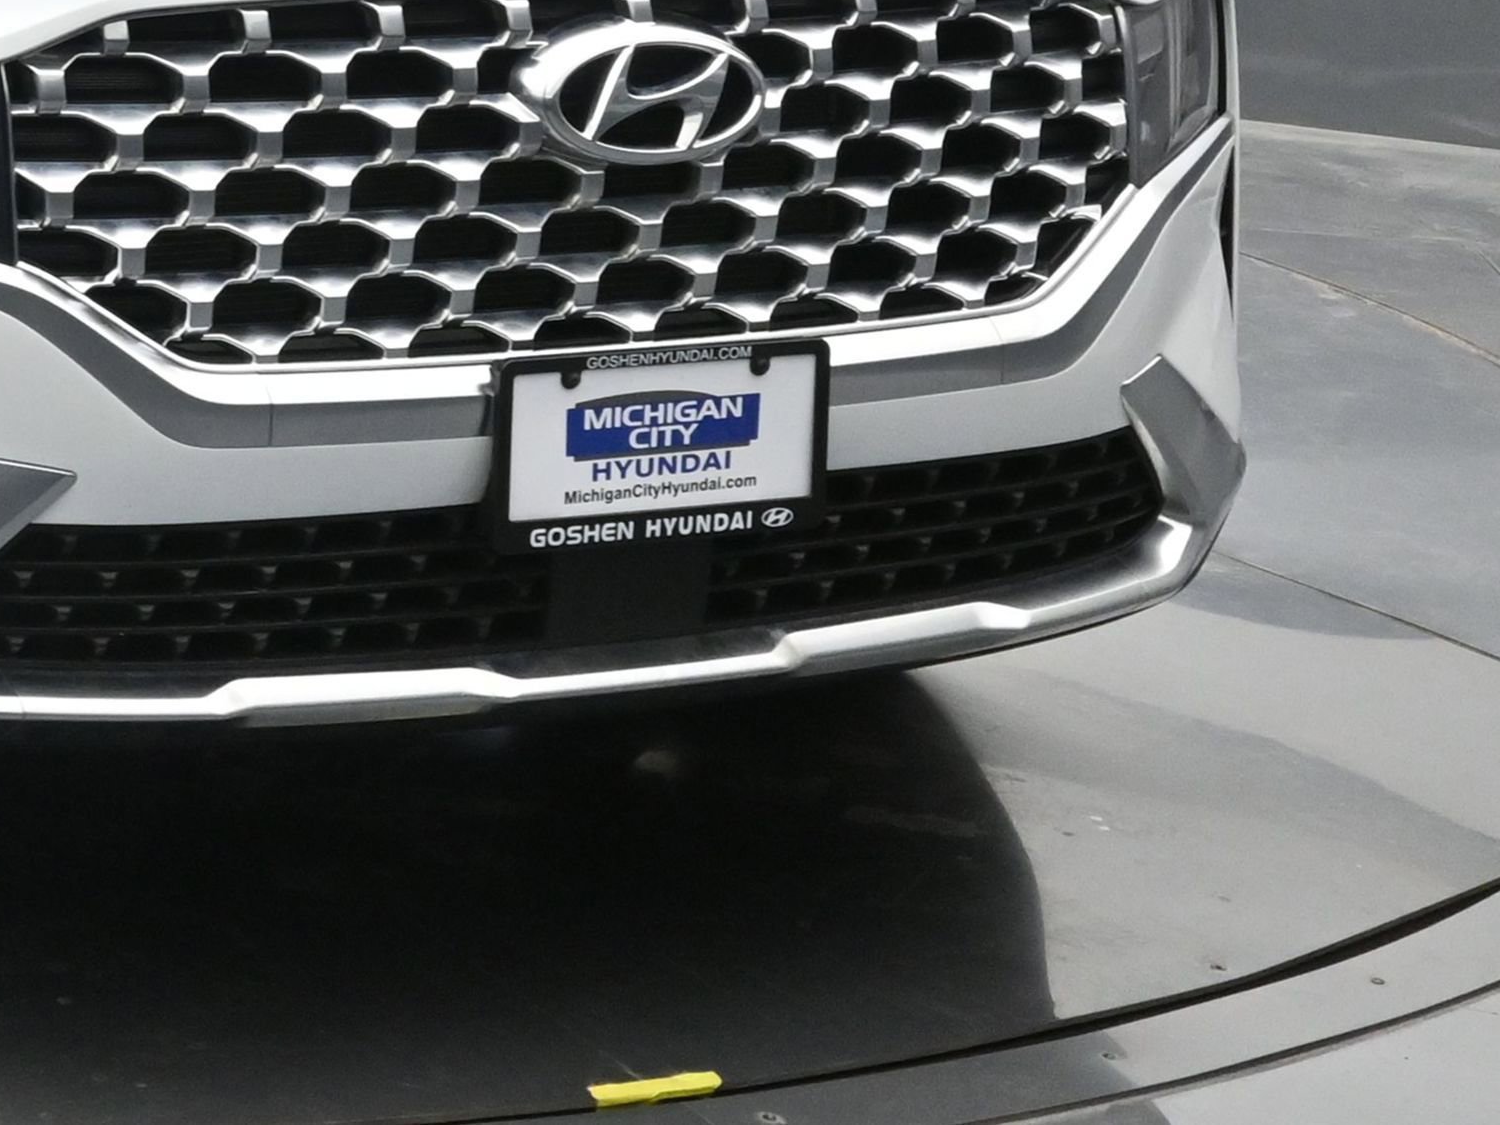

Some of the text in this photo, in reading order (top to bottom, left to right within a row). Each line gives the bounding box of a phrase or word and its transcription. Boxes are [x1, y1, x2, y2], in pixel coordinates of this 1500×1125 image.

[586, 346, 752, 370] GOSHENHYUNDAI.COM
[583, 396, 743, 431] MICHIGAN
[628, 424, 699, 450] CITY
[592, 451, 732, 482] HYUNDAI
[564, 475, 757, 505] MichiganCityHyundai.com
[529, 510, 753, 548] GOSHEN HYUNDAI
